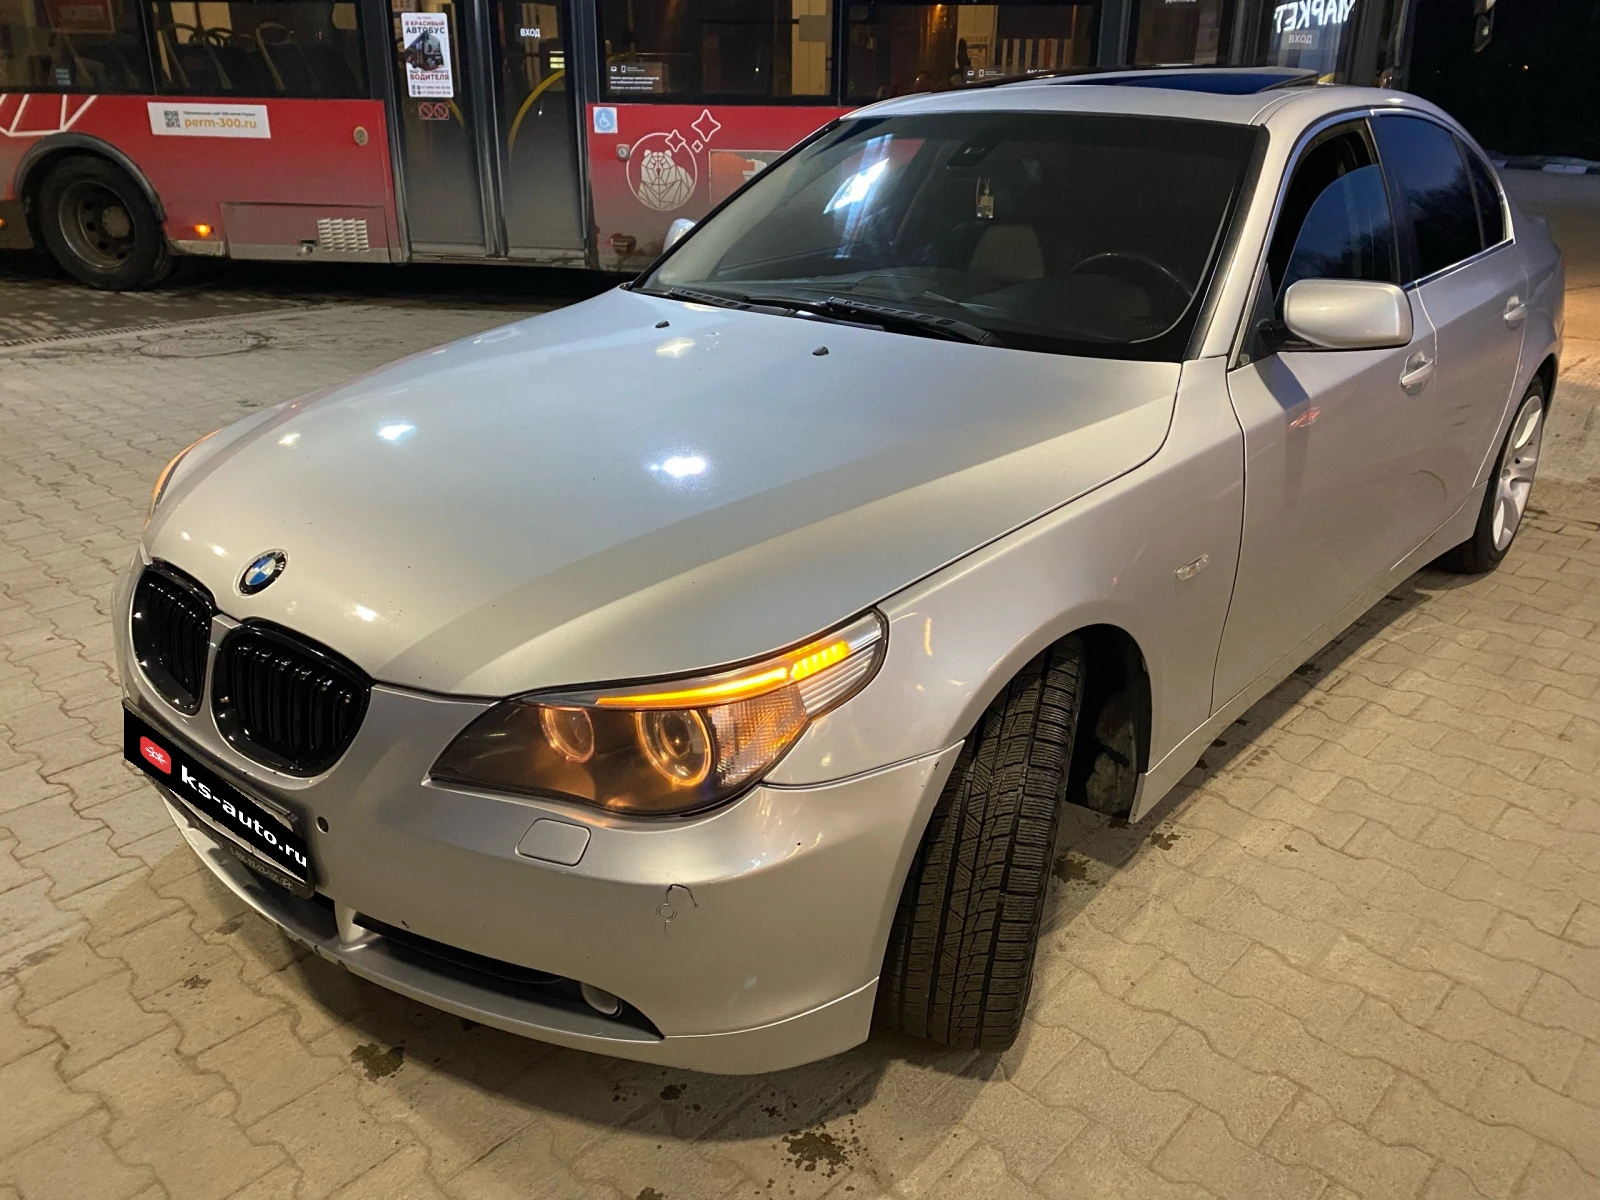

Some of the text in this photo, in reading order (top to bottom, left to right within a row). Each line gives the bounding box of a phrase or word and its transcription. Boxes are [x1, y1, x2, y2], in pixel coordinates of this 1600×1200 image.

[406, 26, 445, 34] АВТОБУС
[520, 28, 540, 38] ВХОД
[1288, 34, 1312, 45] ВХОД
[410, 73, 449, 81] ВОДИТЕЛЯ
[184, 117, 257, 129] perm-300.ru
